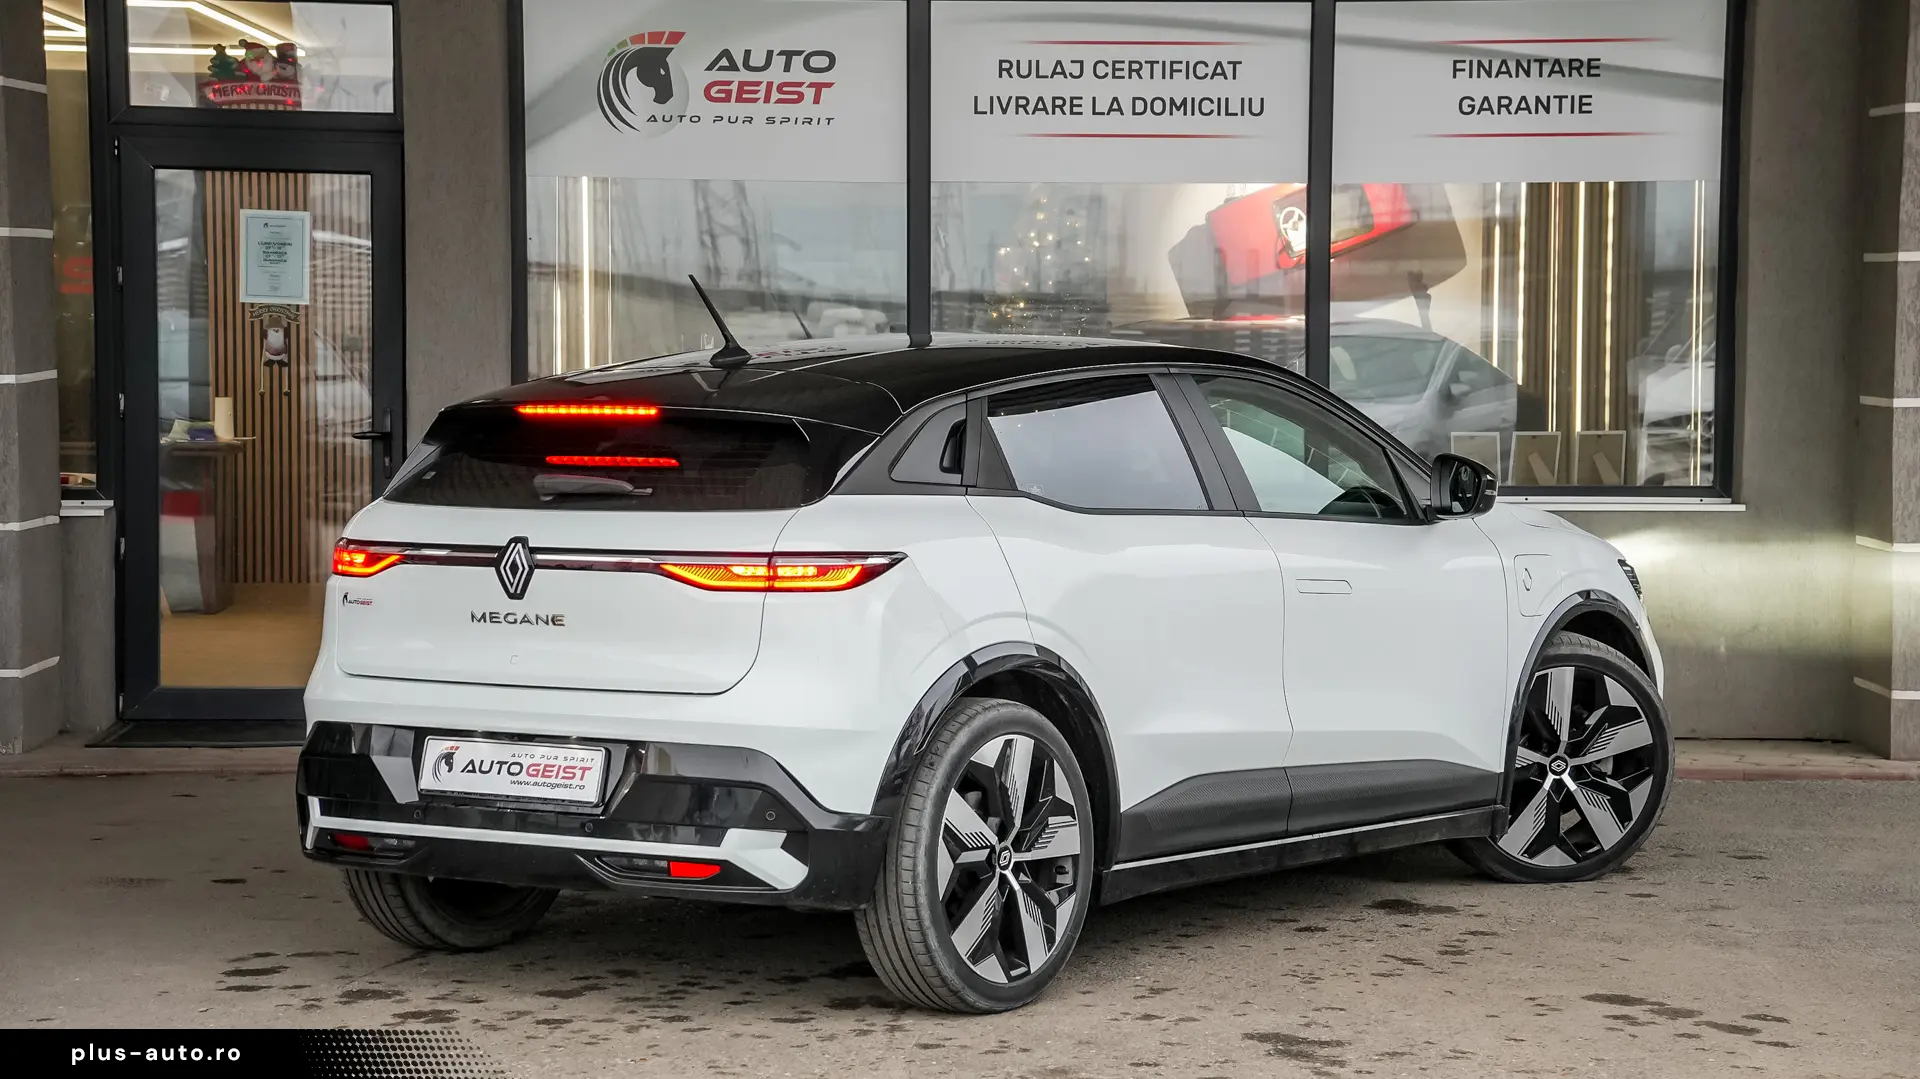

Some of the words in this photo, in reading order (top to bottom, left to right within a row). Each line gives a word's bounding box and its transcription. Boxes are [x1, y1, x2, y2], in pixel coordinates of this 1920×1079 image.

[703, 48, 837, 74] AUTO
[998, 59, 1085, 79] RULAJ
[1092, 59, 1243, 80] CERTIFICAT
[1452, 57, 1602, 79] FINANTARE
[211, 83, 254, 99] MERRY
[703, 80, 836, 105] GEIST
[973, 95, 1084, 115] LIVRARE
[1091, 96, 1125, 116] LA
[1131, 96, 1265, 117] DOMICILIU
[1458, 94, 1593, 116] GARANTIE
[646, 114, 702, 124] AUTO
[712, 115, 755, 125] PUR
[765, 116, 836, 126] SPIRIT
[470, 610, 566, 627] MEGANE
[510, 752, 536, 760] AUTO
[562, 755, 596, 763] SPIRIT
[509, 779, 586, 791] www.autogeist.ro
